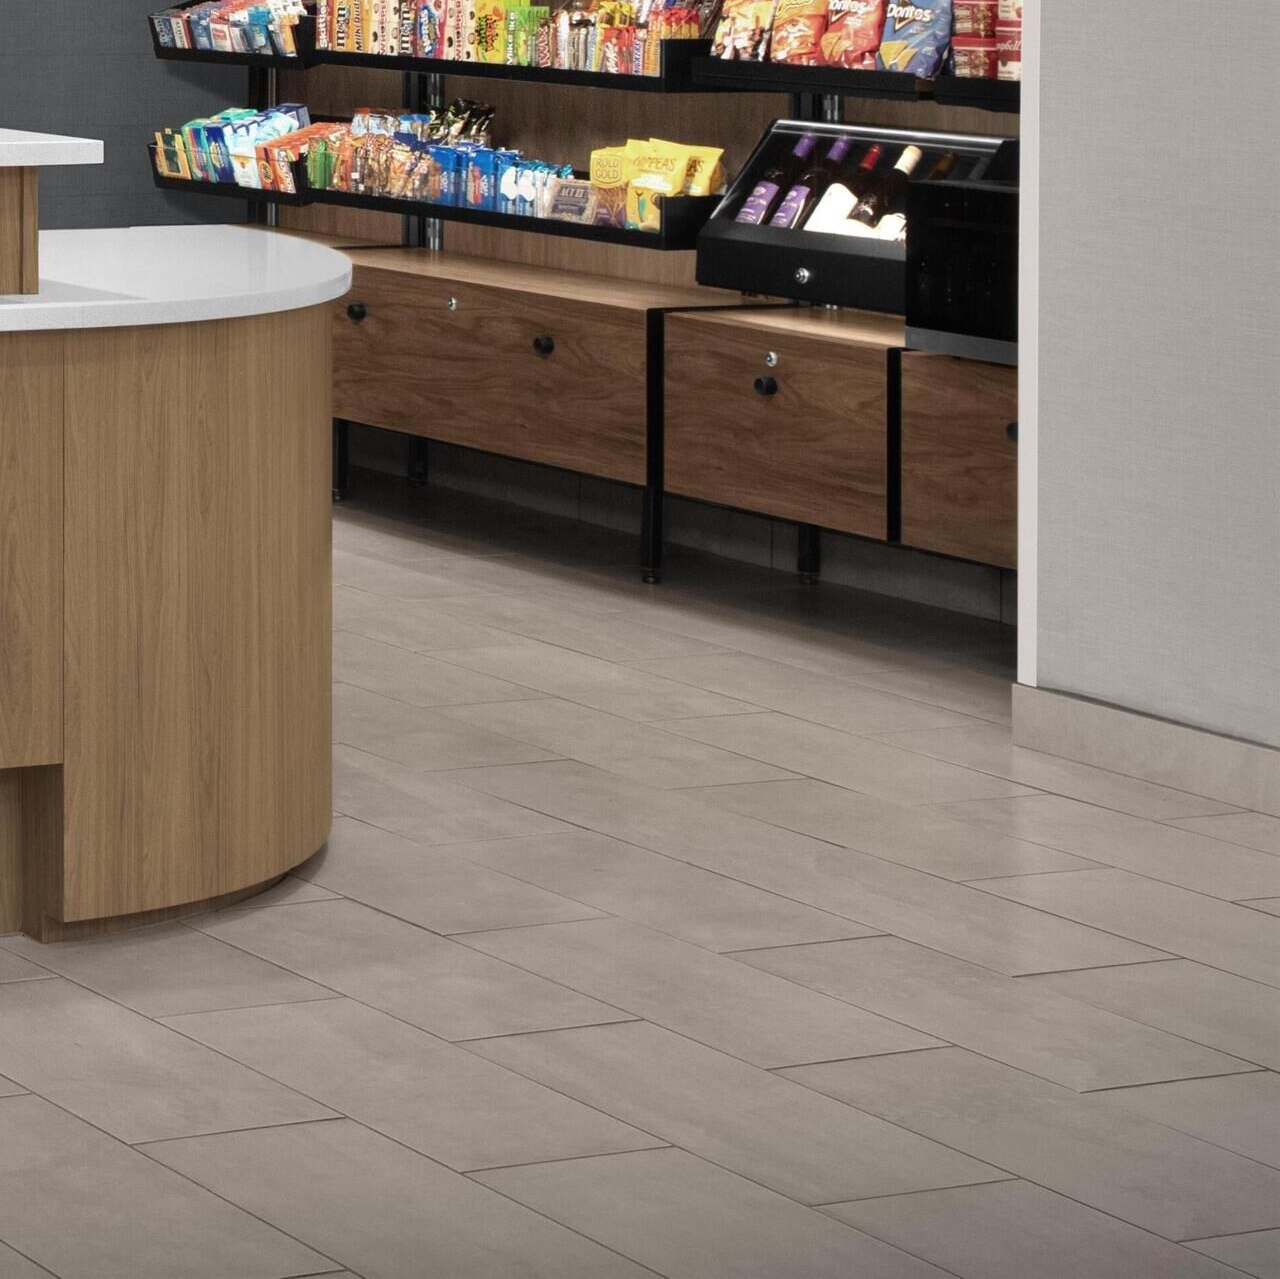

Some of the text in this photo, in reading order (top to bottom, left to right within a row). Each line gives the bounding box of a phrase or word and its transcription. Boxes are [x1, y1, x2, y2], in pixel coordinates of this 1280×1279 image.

[886, 2, 932, 22] Doritos
[354, 29, 363, 52] Milk
[595, 169, 620, 179] GOLD
